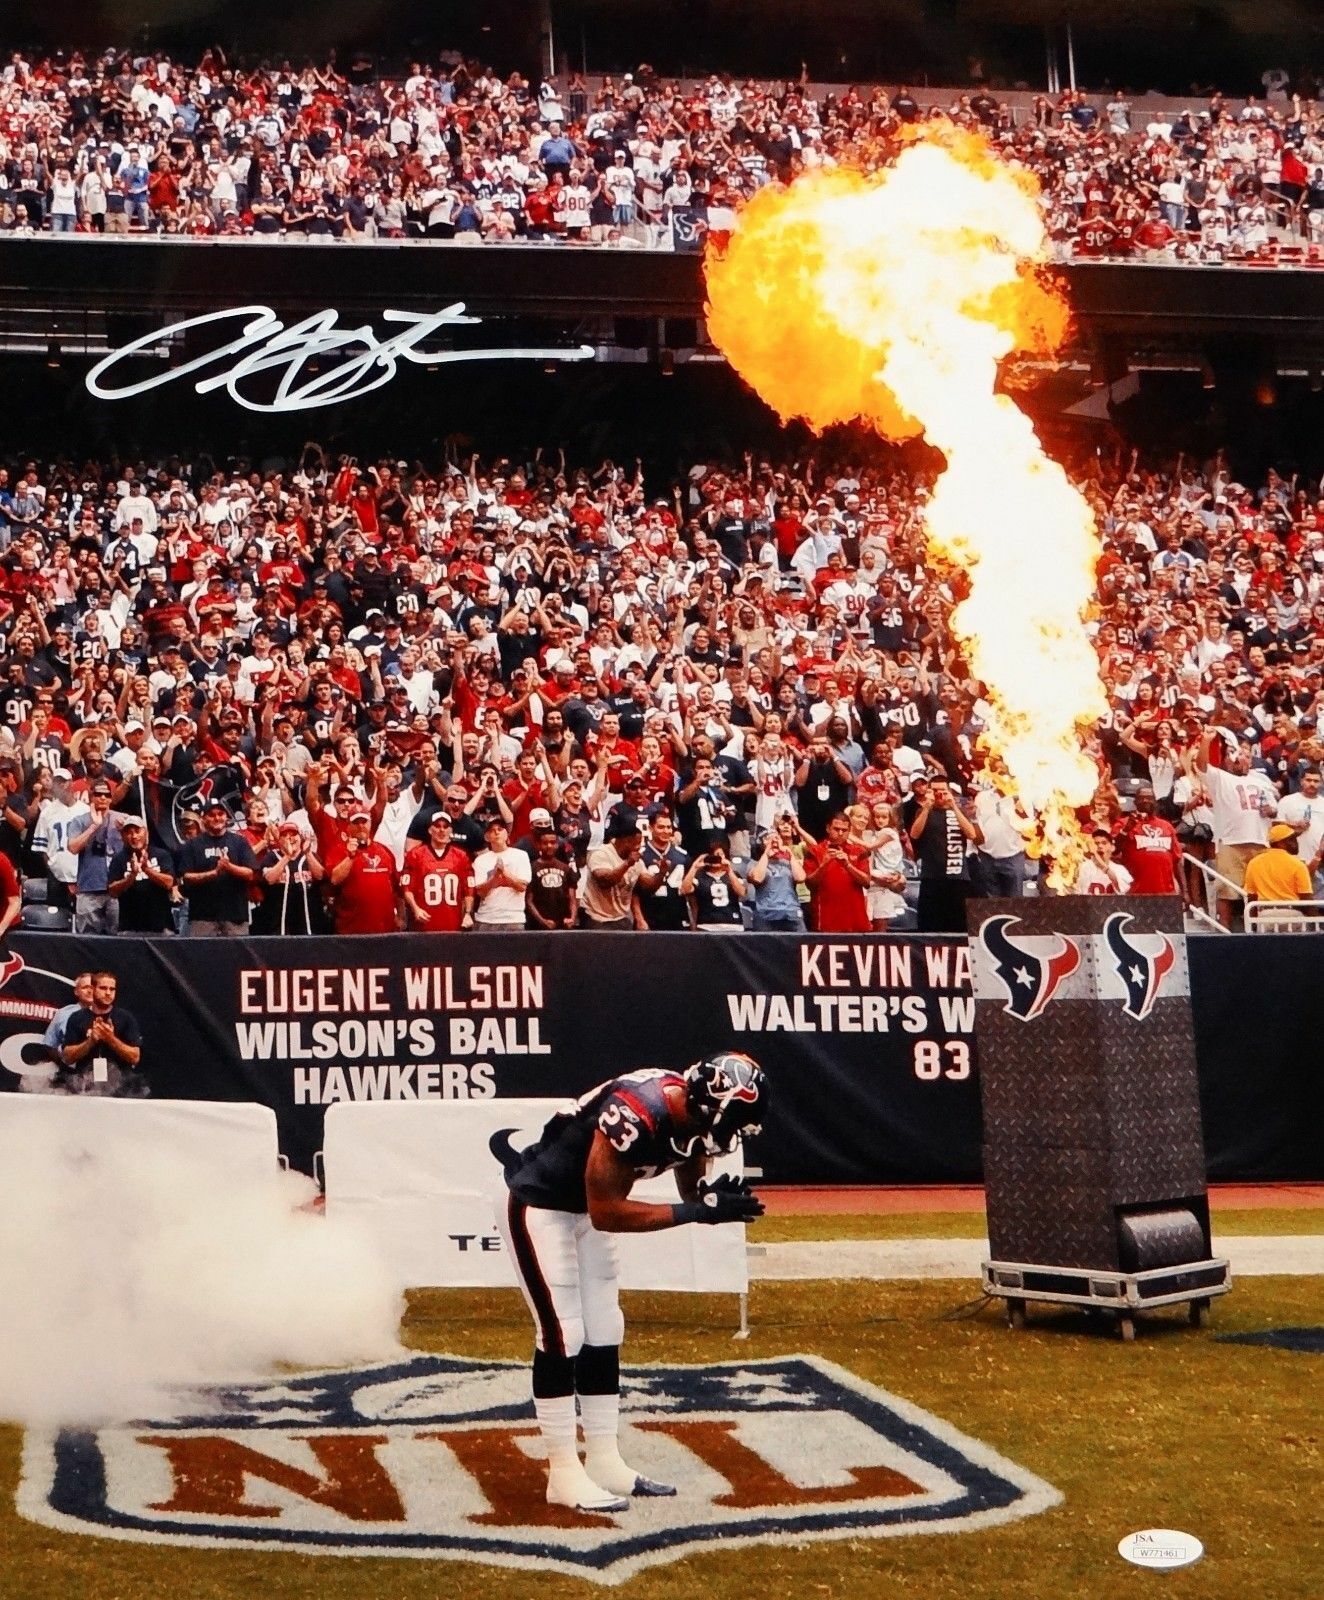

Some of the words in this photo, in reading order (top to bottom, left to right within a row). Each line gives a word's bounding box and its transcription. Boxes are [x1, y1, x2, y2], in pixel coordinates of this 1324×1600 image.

[569, 197, 585, 211] 80
[845, 594, 866, 611] 80
[83, 640, 102, 659] 20
[423, 873, 459, 905] 80
[711, 883, 730, 907] 9
[800, 944, 912, 987] KEVIN
[240, 968, 391, 1012] EUGENE
[404, 966, 543, 1009] WILSON
[727, 994, 928, 1033] WALTER'S
[235, 1018, 435, 1060] WILSON'S
[449, 1017, 552, 1055] BALL
[914, 1040, 970, 1080] 83
[294, 1062, 497, 1105] HAWKERS
[598, 1103, 640, 1152] 23
[136, 1419, 929, 1529] NFL
[1133, 1534, 1154, 1544] JSA
